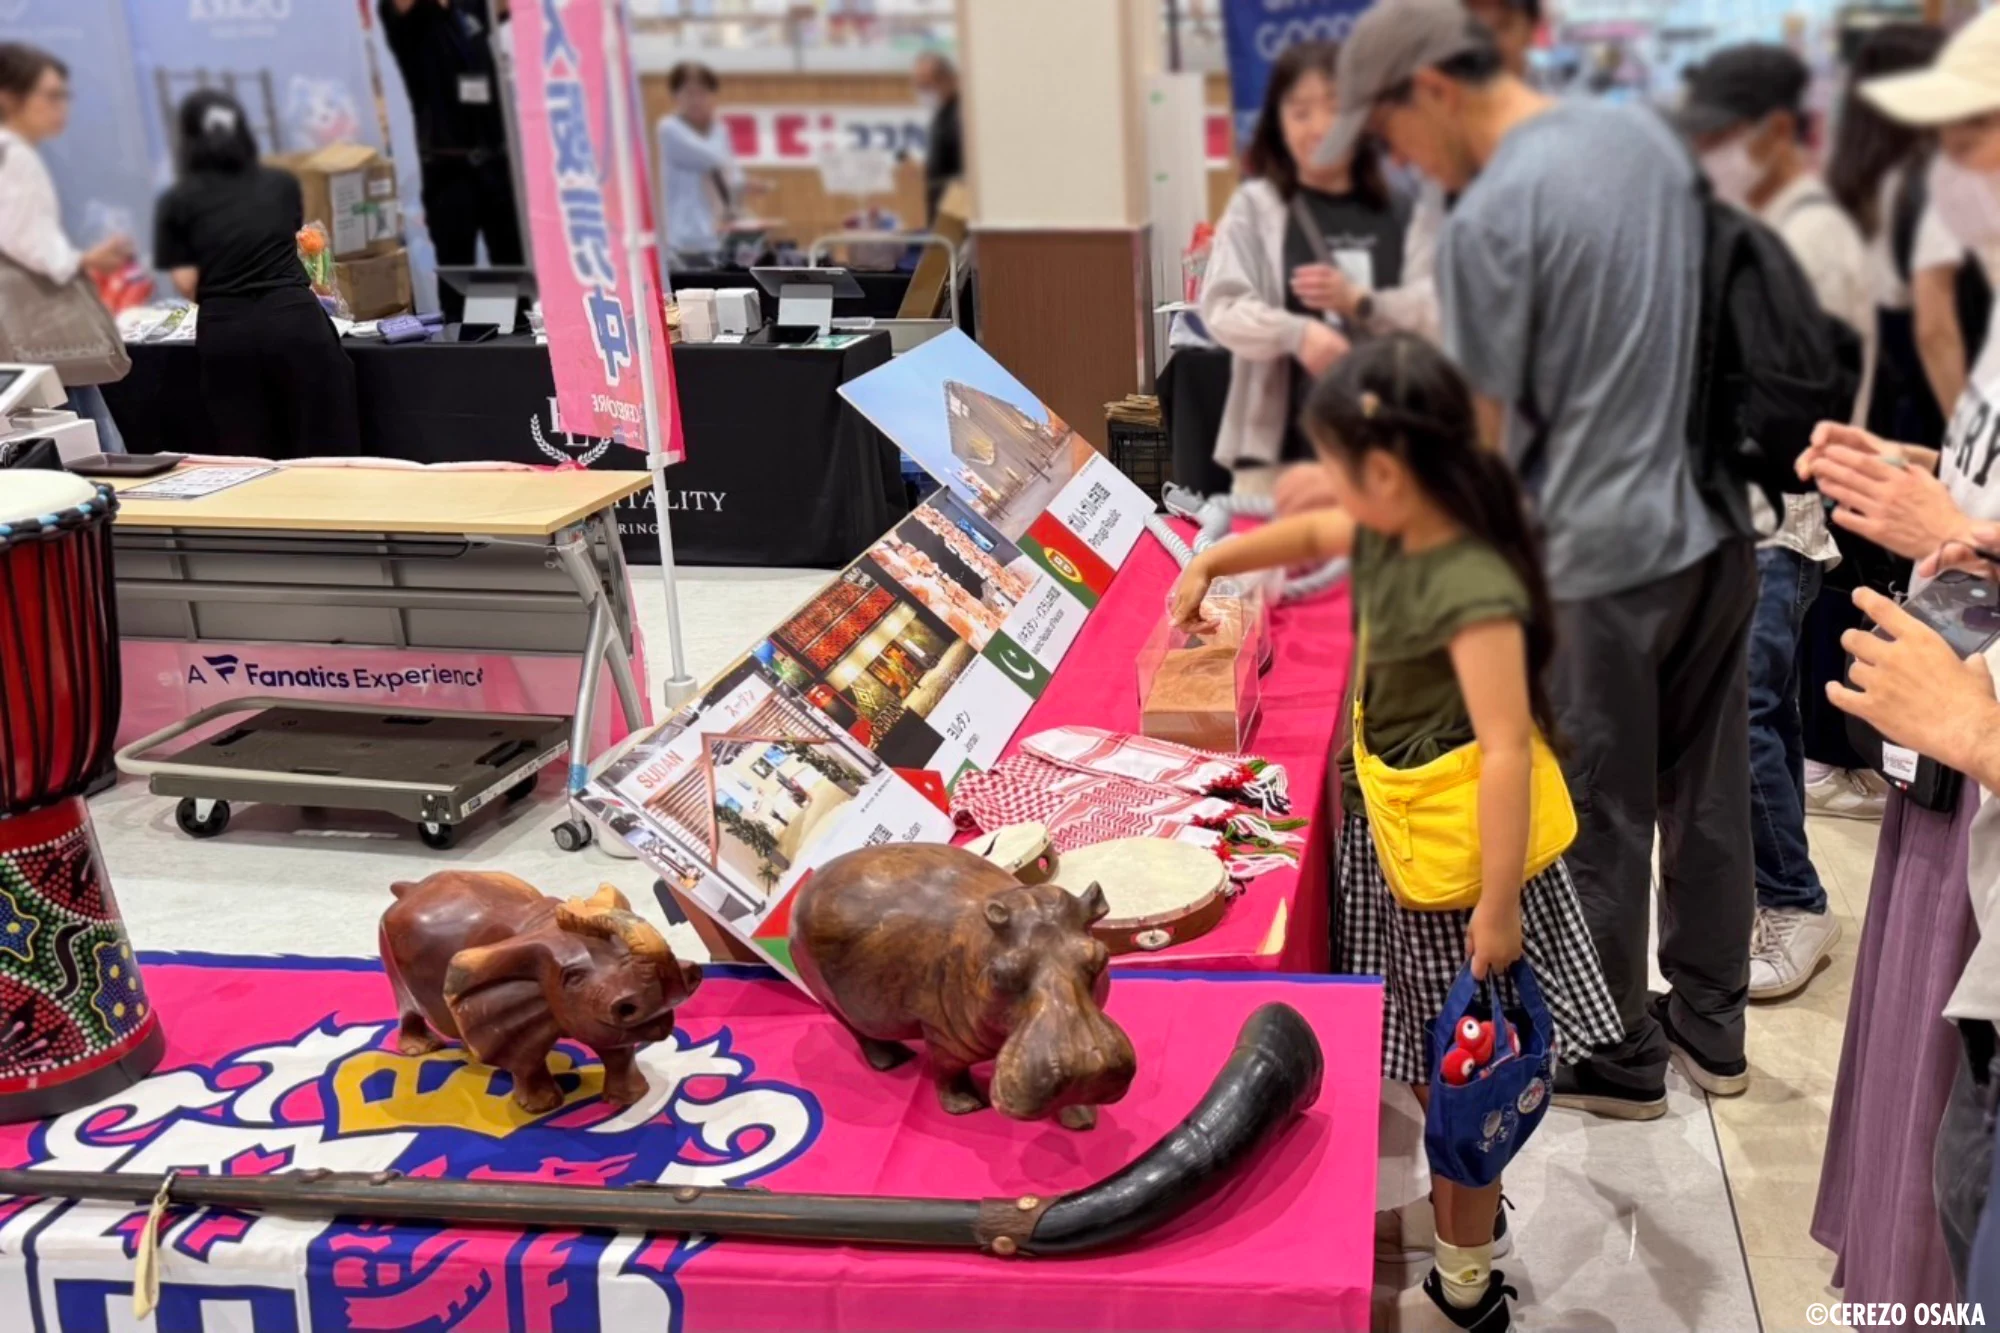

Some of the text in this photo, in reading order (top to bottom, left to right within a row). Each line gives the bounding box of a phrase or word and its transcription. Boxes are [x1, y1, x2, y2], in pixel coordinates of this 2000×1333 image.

[188, 664, 208, 684] A
[244, 663, 350, 688] Fanatics
[635, 748, 686, 791] SUDAN
